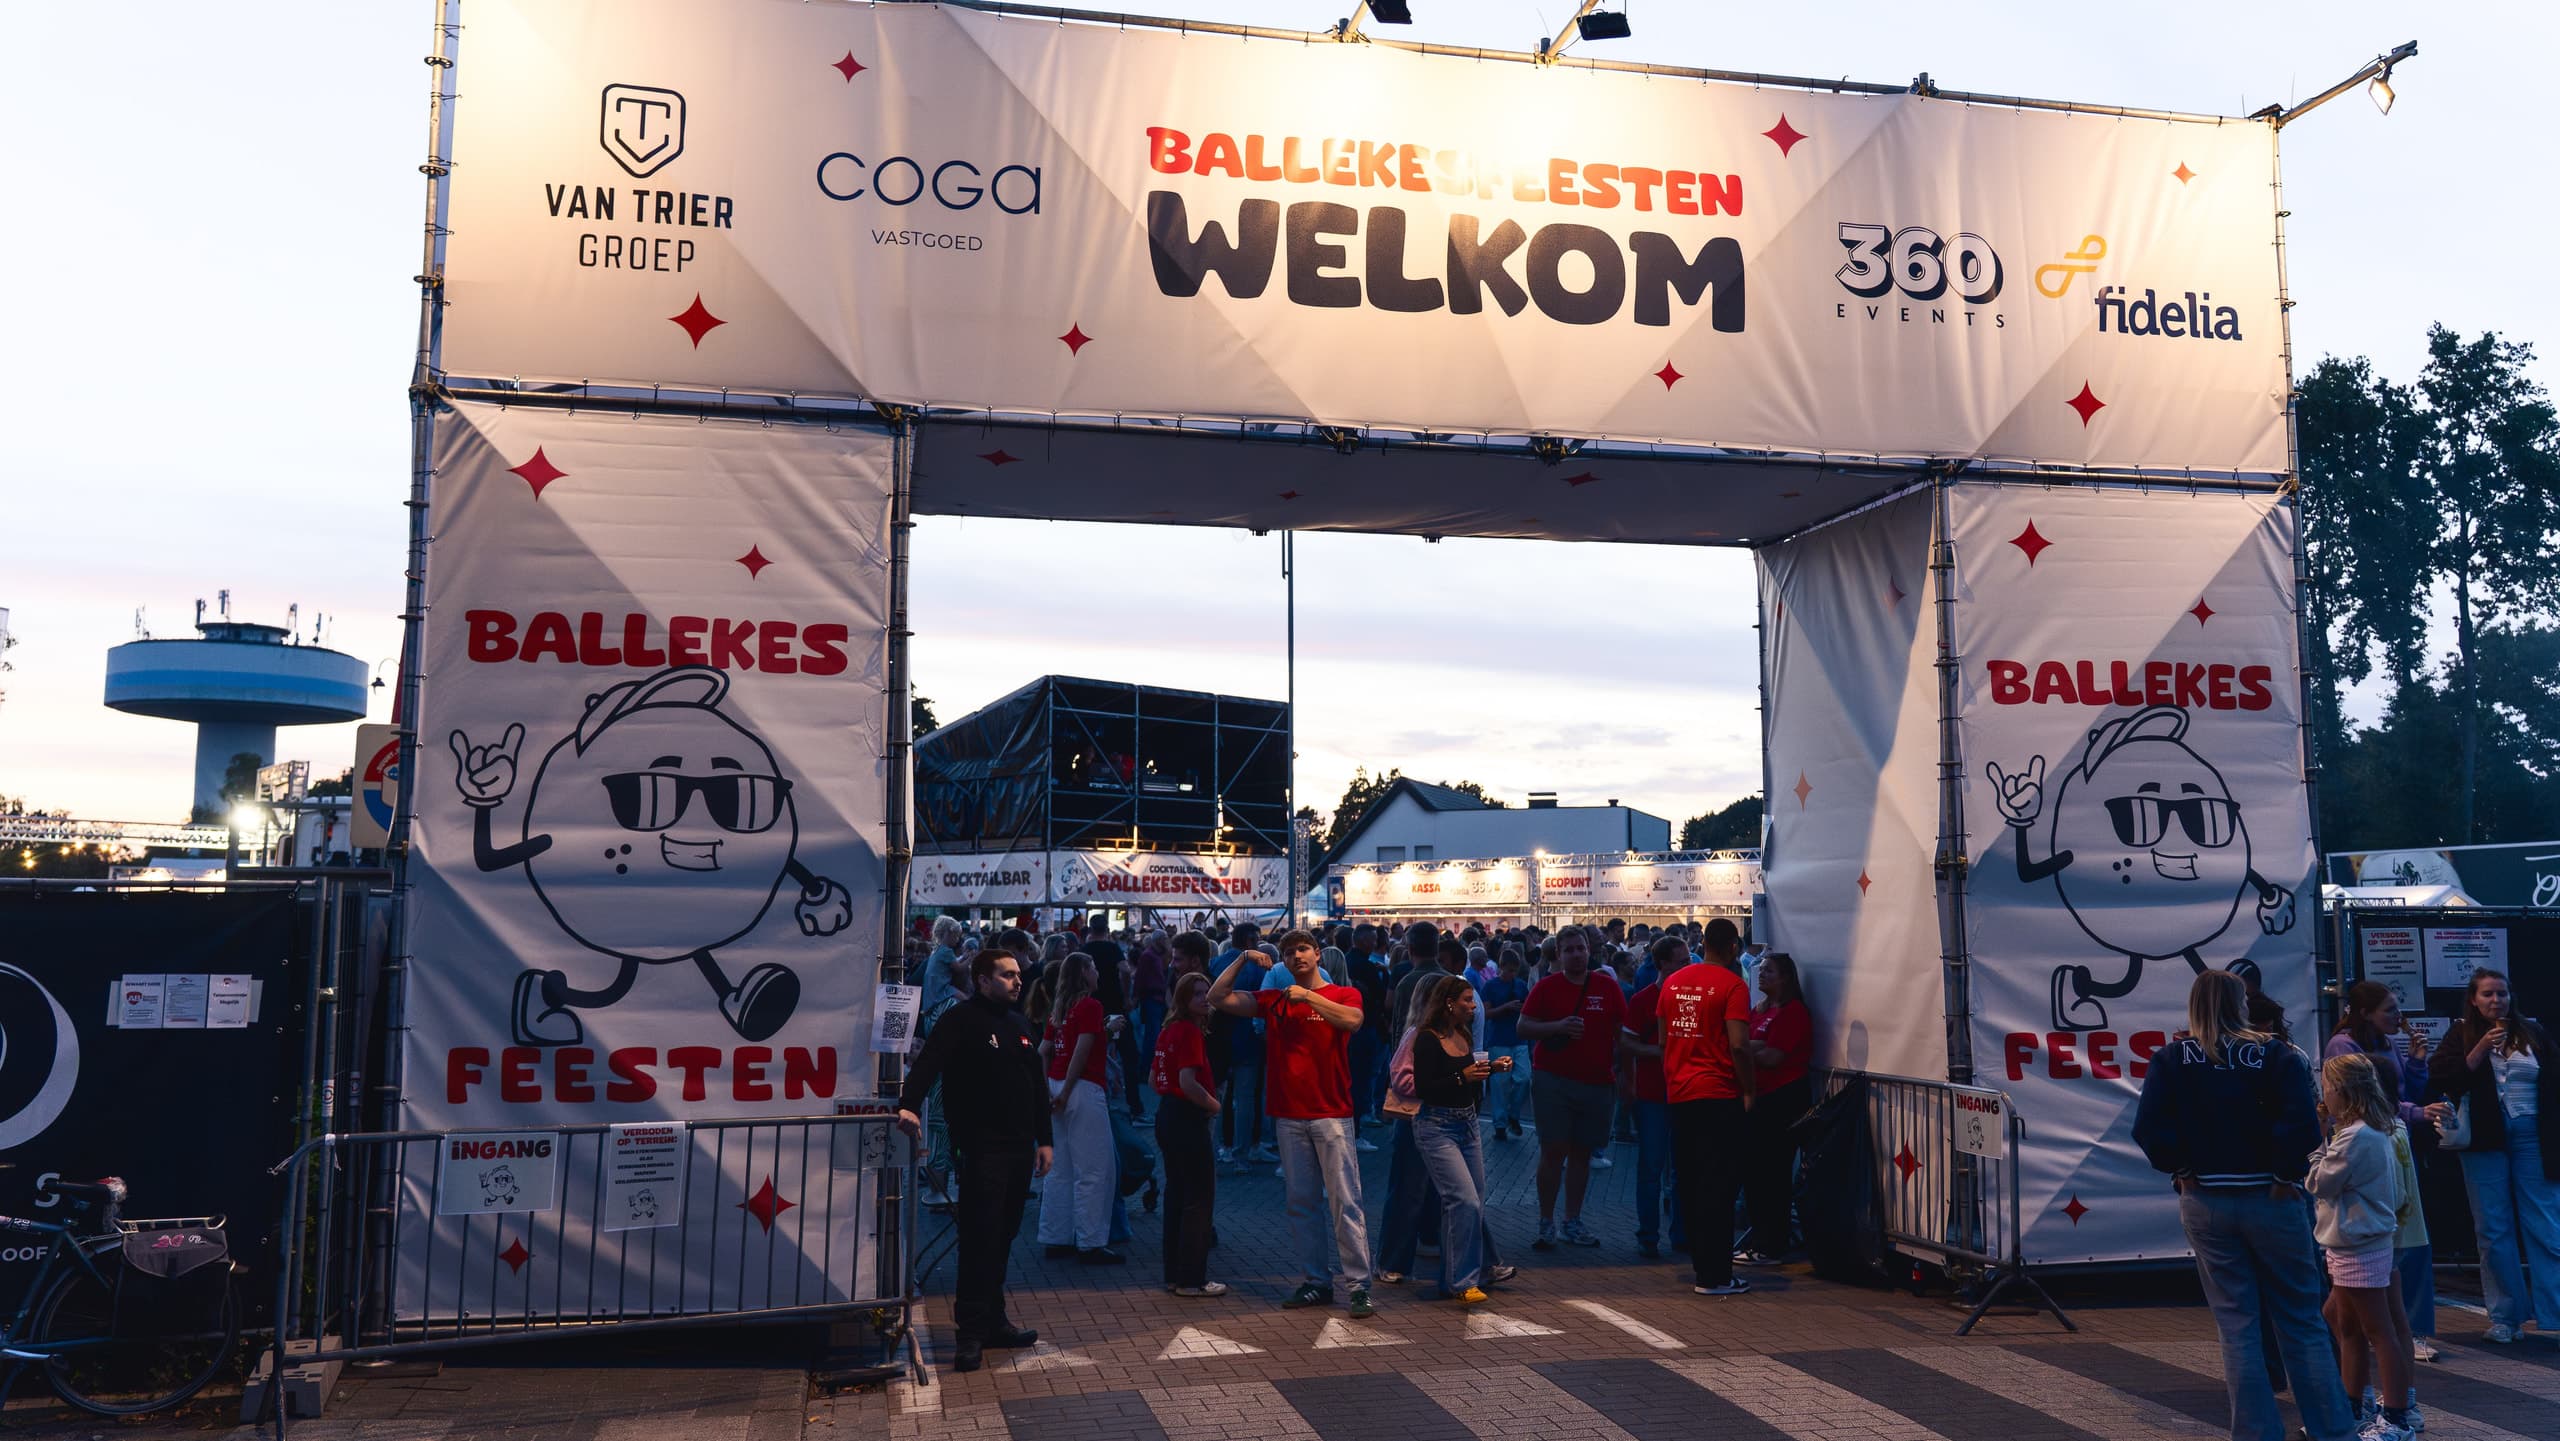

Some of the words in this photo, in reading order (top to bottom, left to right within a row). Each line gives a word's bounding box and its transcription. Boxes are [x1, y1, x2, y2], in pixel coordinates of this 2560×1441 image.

[1146, 126, 1743, 217] BALLEKESFEESTEN
[545, 183, 615, 222] VAN
[633, 189, 733, 229] TRIER
[579, 233, 696, 273] GROEP
[871, 228, 984, 252] VASTGOED
[1147, 190, 1745, 333] WELKOM
[1836, 221, 2004, 304] 360
[1837, 303, 2006, 328] EVENTS
[2094, 285, 2243, 341] fidelia
[465, 609, 849, 676] BALLEKES
[1986, 659, 2273, 712] BALLEKES
[1096, 874, 1252, 895] BALLEKESFEESTEN
[1411, 882, 1441, 894] KASSA
[1545, 877, 1592, 889] ECOPUNT
[2004, 1029, 2191, 1081] FEES
[2181, 1034, 2266, 1070] NYC
[446, 1045, 838, 1104] FEESTEN
[617, 1138, 631, 1146] OP
[622, 1127, 674, 1137] VERBODEN
